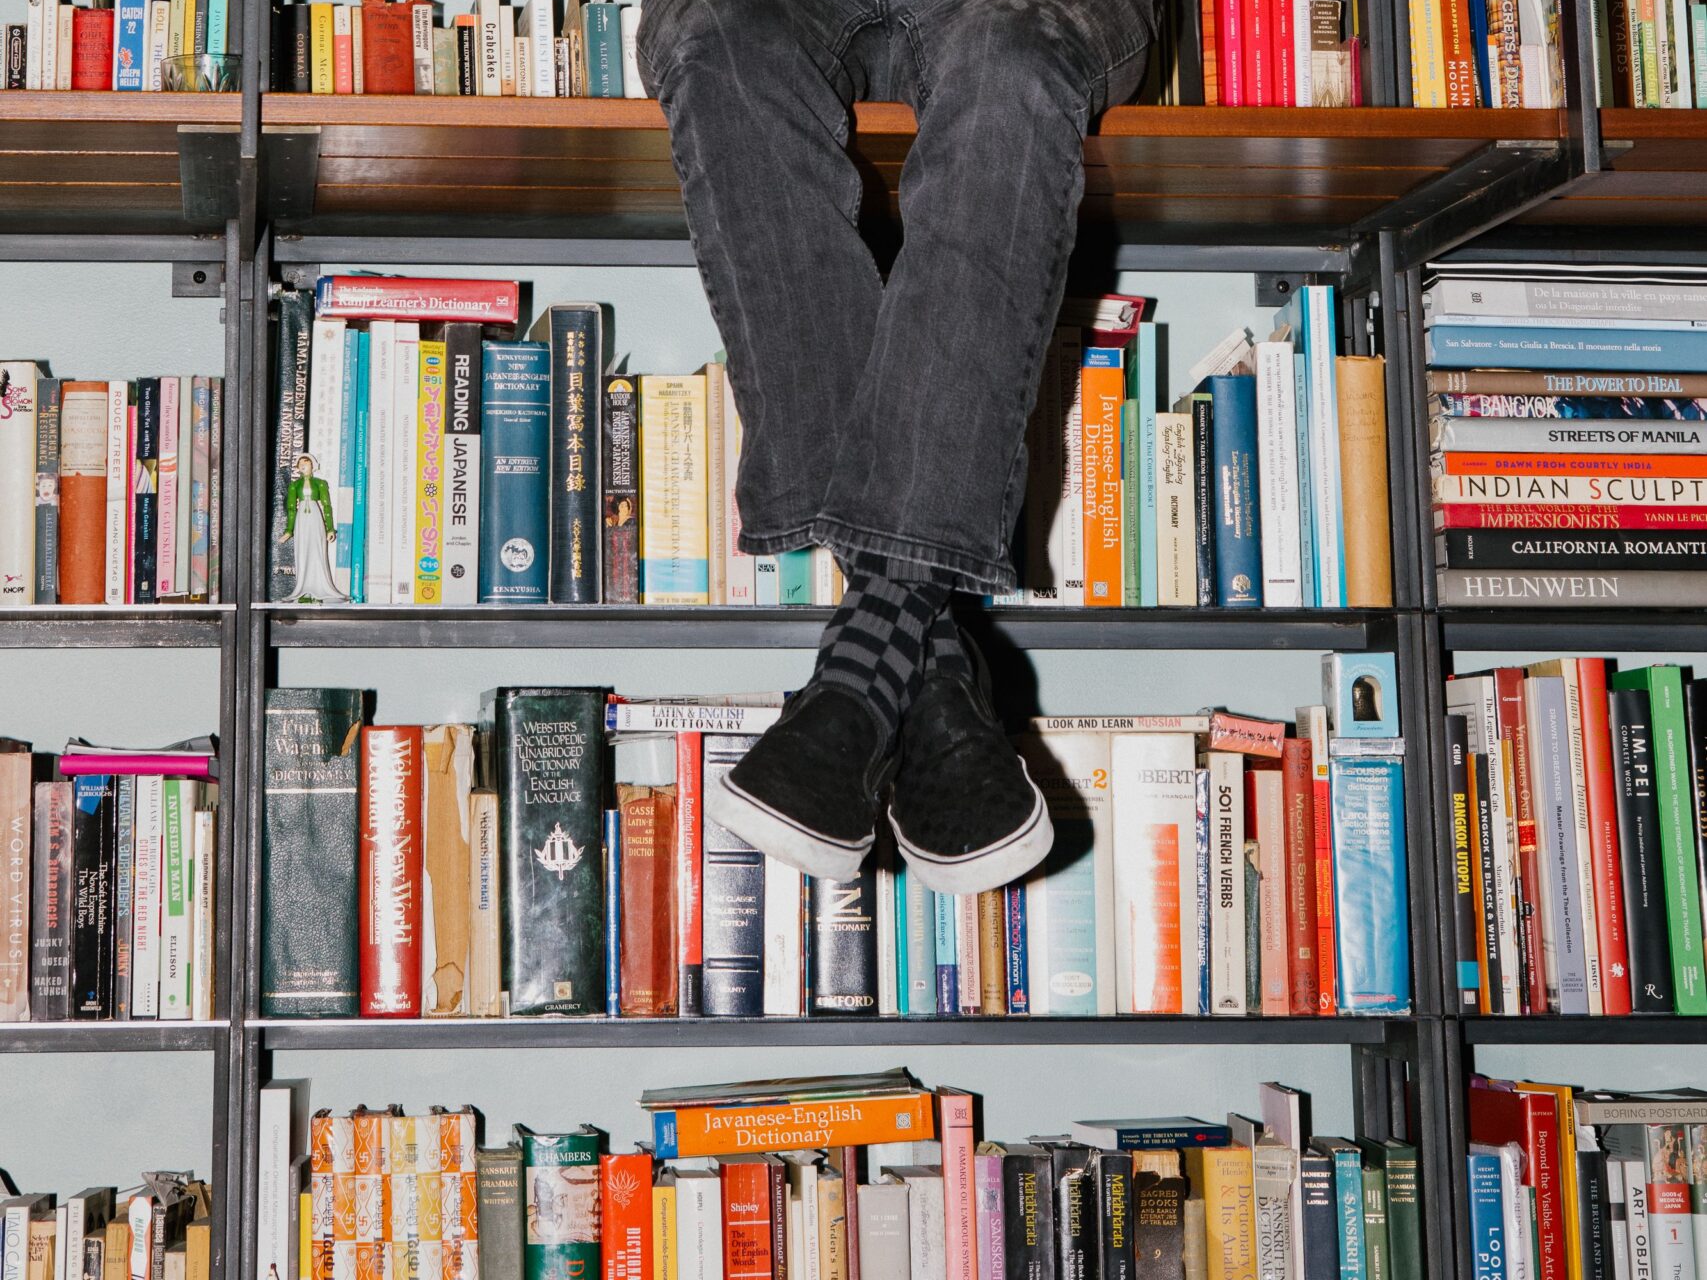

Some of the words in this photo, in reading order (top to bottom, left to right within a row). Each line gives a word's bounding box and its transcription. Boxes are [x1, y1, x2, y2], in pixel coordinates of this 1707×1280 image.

[485, 23, 498, 79] Crabcakes
[430, 298, 492, 312] Dictionary
[453, 354, 469, 431] READING
[1544, 375, 1573, 392] THE
[1576, 375, 1624, 392] POWER
[1626, 377, 1646, 392] TO
[1648, 376, 1683, 393] HEAL
[1479, 397, 1559, 418] BANGKOK
[612, 411, 621, 485] ENGLISH-JAPANESE
[621, 411, 630, 485] JAPANESE-ENGLISH
[1548, 430, 1615, 442] STREETS
[1619, 431, 1639, 442] OF
[1642, 431, 1700, 443] MANILA
[452, 437, 467, 525] JAPANESE
[1083, 424, 1100, 519] Dictionary
[1099, 393, 1118, 549] Javanese-English
[1458, 476, 1569, 498] INDIAN
[1480, 513, 1620, 529] IMPRESSIONISTS
[1512, 542, 1619, 554] CALIFORNIA
[1464, 577, 1618, 597] HELNWEIN
[652, 707, 684, 718] LATIN
[687, 708, 695, 718] &
[699, 708, 744, 719] ENGLISH
[654, 719, 742, 730] DICTIONARY
[1047, 720, 1074, 728] LOOK
[1077, 720, 1097, 728] AND
[1101, 719, 1133, 728] LEARN
[1137, 718, 1181, 727] RUSSIAN
[514, 734, 587, 746] ENCYCLOPEDIC
[522, 722, 577, 733] WEBSTER'S
[518, 747, 584, 758] UNABRIDGED
[1453, 744, 1462, 765] CHUA
[1621, 725, 1629, 765] COMPLETE
[521, 759, 582, 770] DICTIONARY
[530, 777, 574, 789] ENGLISH
[1624, 770, 1632, 797] WORKS
[524, 790, 582, 804] LANGUAGE
[1219, 785, 1232, 812] 501
[168, 794, 178, 866] INVISIBLE
[1296, 793, 1306, 856] Modern
[1453, 793, 1467, 849] BANGKOK
[1480, 800, 1490, 851] BANGKOK
[9, 817, 24, 883] WORD
[1219, 817, 1232, 864] FRENCH
[99, 862, 107, 878] The
[1455, 852, 1470, 894] UTOPIA
[1483, 857, 1492, 867] IN
[79, 868, 87, 886] The
[89, 871, 97, 893] Nova
[98, 880, 107, 897] Soft
[171, 868, 180, 902] MAN
[1221, 868, 1233, 907] VERBS
[79, 888, 87, 908] Wild
[1296, 862, 1308, 931] Spanish
[1484, 873, 1493, 910] BLACK
[77, 909, 87, 928] Boys
[87, 895, 97, 925] Express
[98, 899, 107, 934] Machine
[9, 894, 22, 957] VIRUS
[1487, 922, 1497, 959] WHITE
[704, 1105, 863, 1134] Javanese-English
[736, 1126, 833, 1147] Dictionary
[1537, 1130, 1550, 1168] Beyond
[1542, 1171, 1551, 1187] the
[730, 1202, 759, 1214] Shipley
[1139, 1199, 1178, 1207] BOOKS
[1543, 1191, 1553, 1230] Visible:
[1633, 1187, 1644, 1218] ART
[1237, 1184, 1254, 1268] Dictionary
